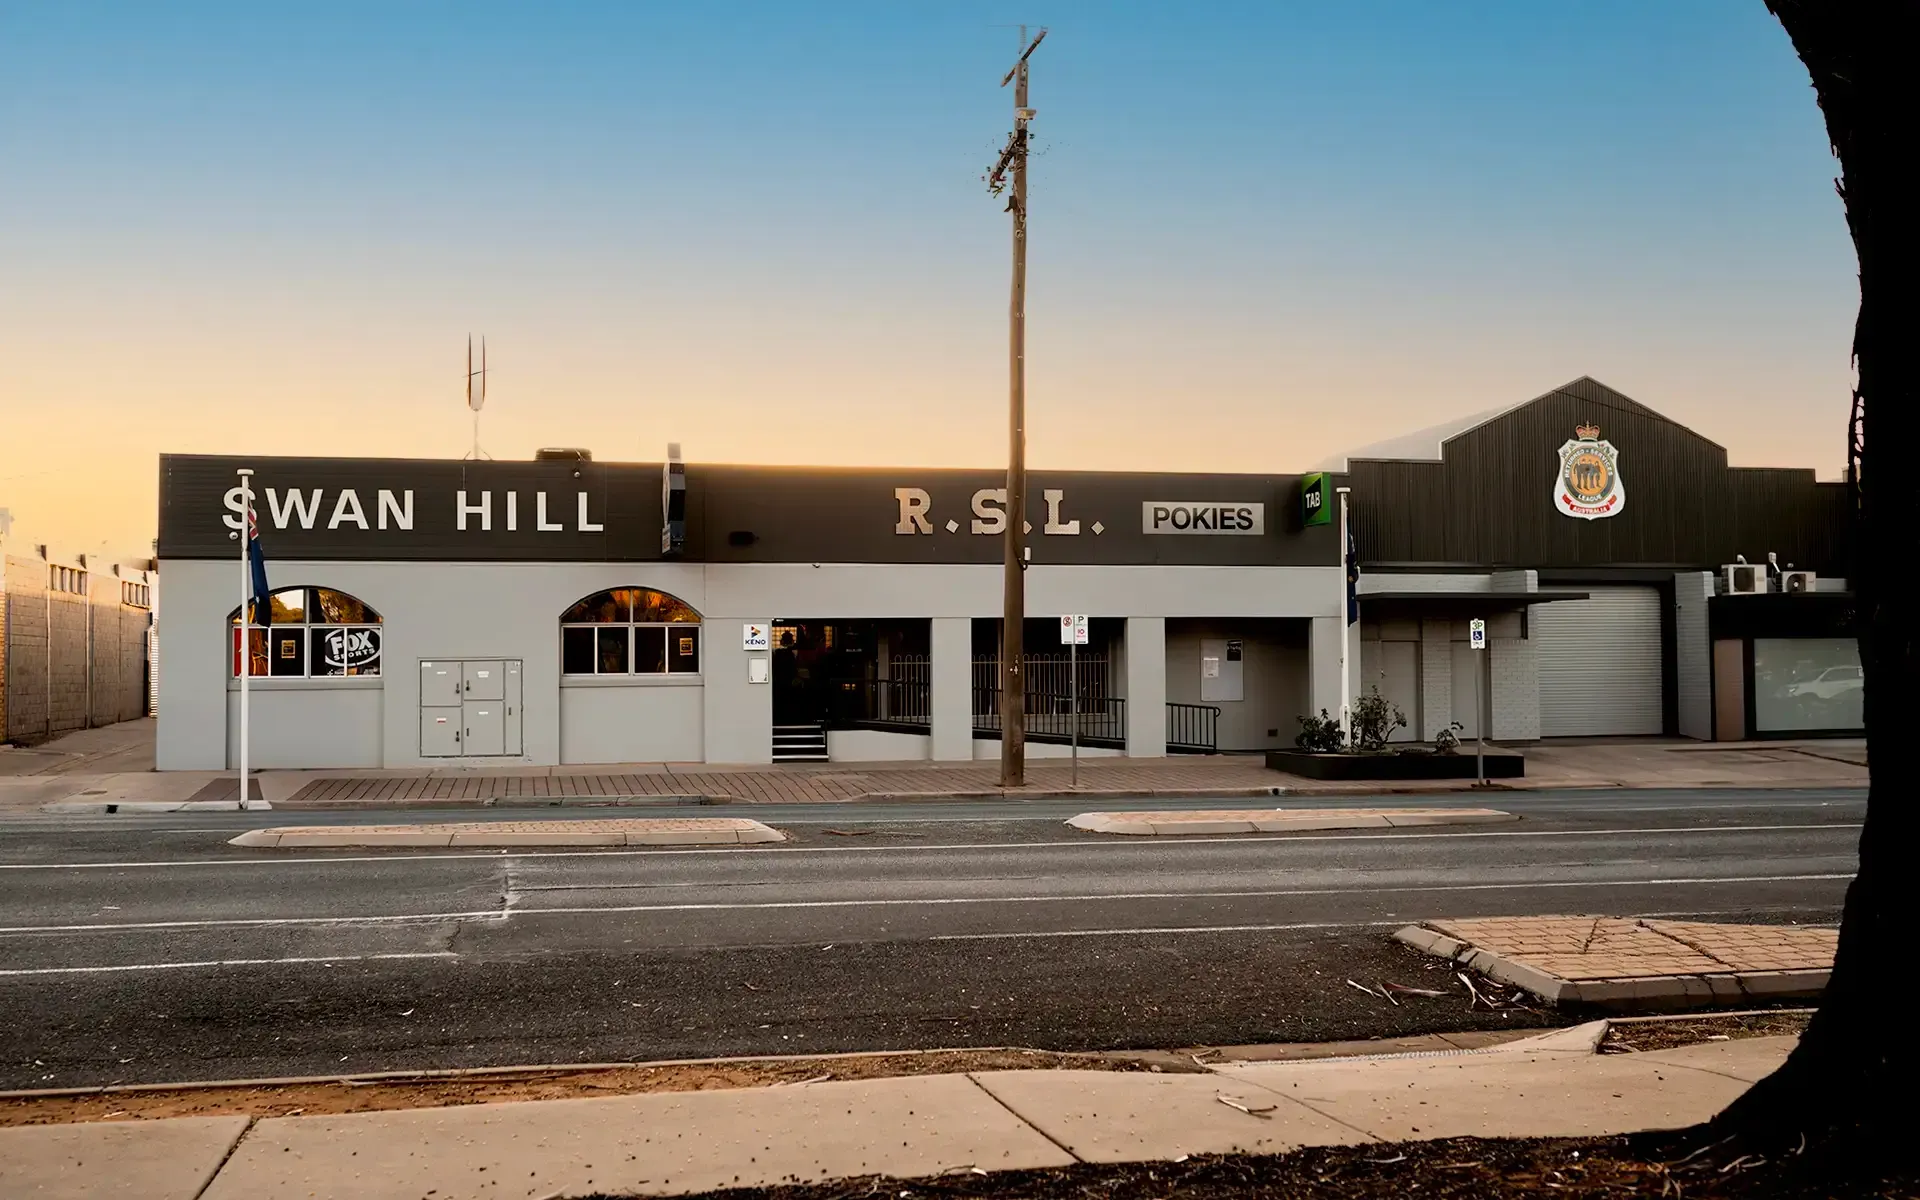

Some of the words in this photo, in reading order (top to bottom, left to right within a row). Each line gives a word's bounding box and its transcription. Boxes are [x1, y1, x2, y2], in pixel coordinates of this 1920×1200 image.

[1590, 448, 1613, 476] SERVICES
[1305, 491, 1321, 508] TAB
[1578, 494, 1602, 502] LEAGUE
[222, 487, 414, 530] SWAN
[457, 490, 604, 531] HILL
[1153, 507, 1254, 530] POKIES
[1572, 506, 1608, 514] AUSTRALIA
[1472, 621, 1483, 630] 3P
[330, 630, 374, 655] FOX
